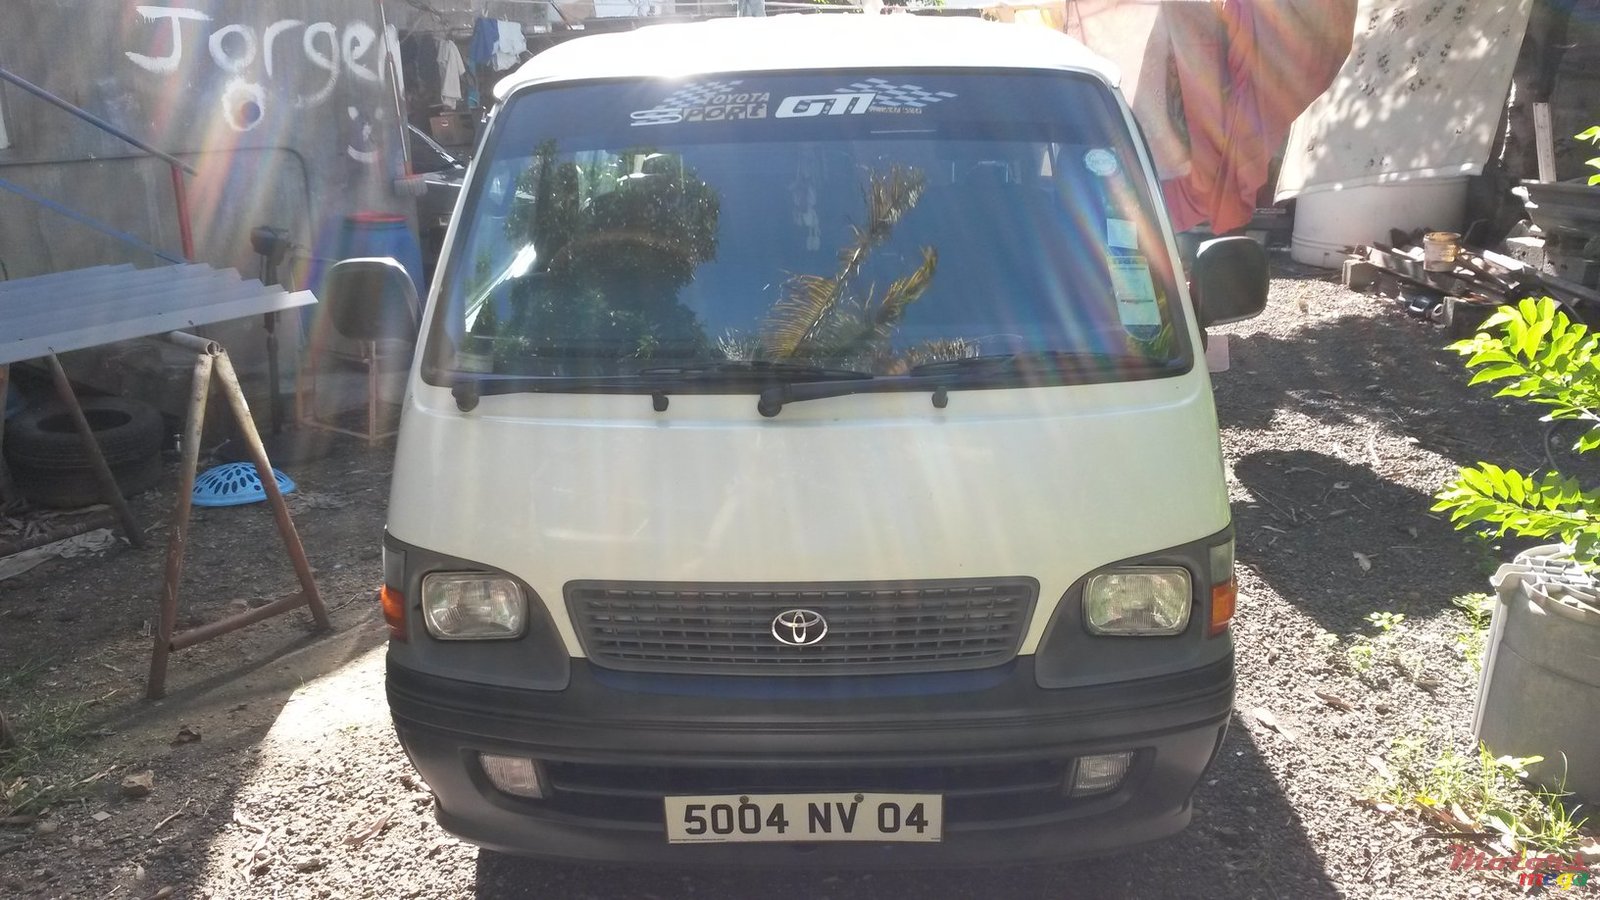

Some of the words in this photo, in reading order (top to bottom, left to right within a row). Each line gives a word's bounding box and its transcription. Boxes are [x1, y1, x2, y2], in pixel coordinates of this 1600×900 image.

[702, 91, 771, 105] TOYOTA
[684, 803, 789, 835] 5004
[808, 802, 859, 833] NV
[877, 802, 929, 833] 04
